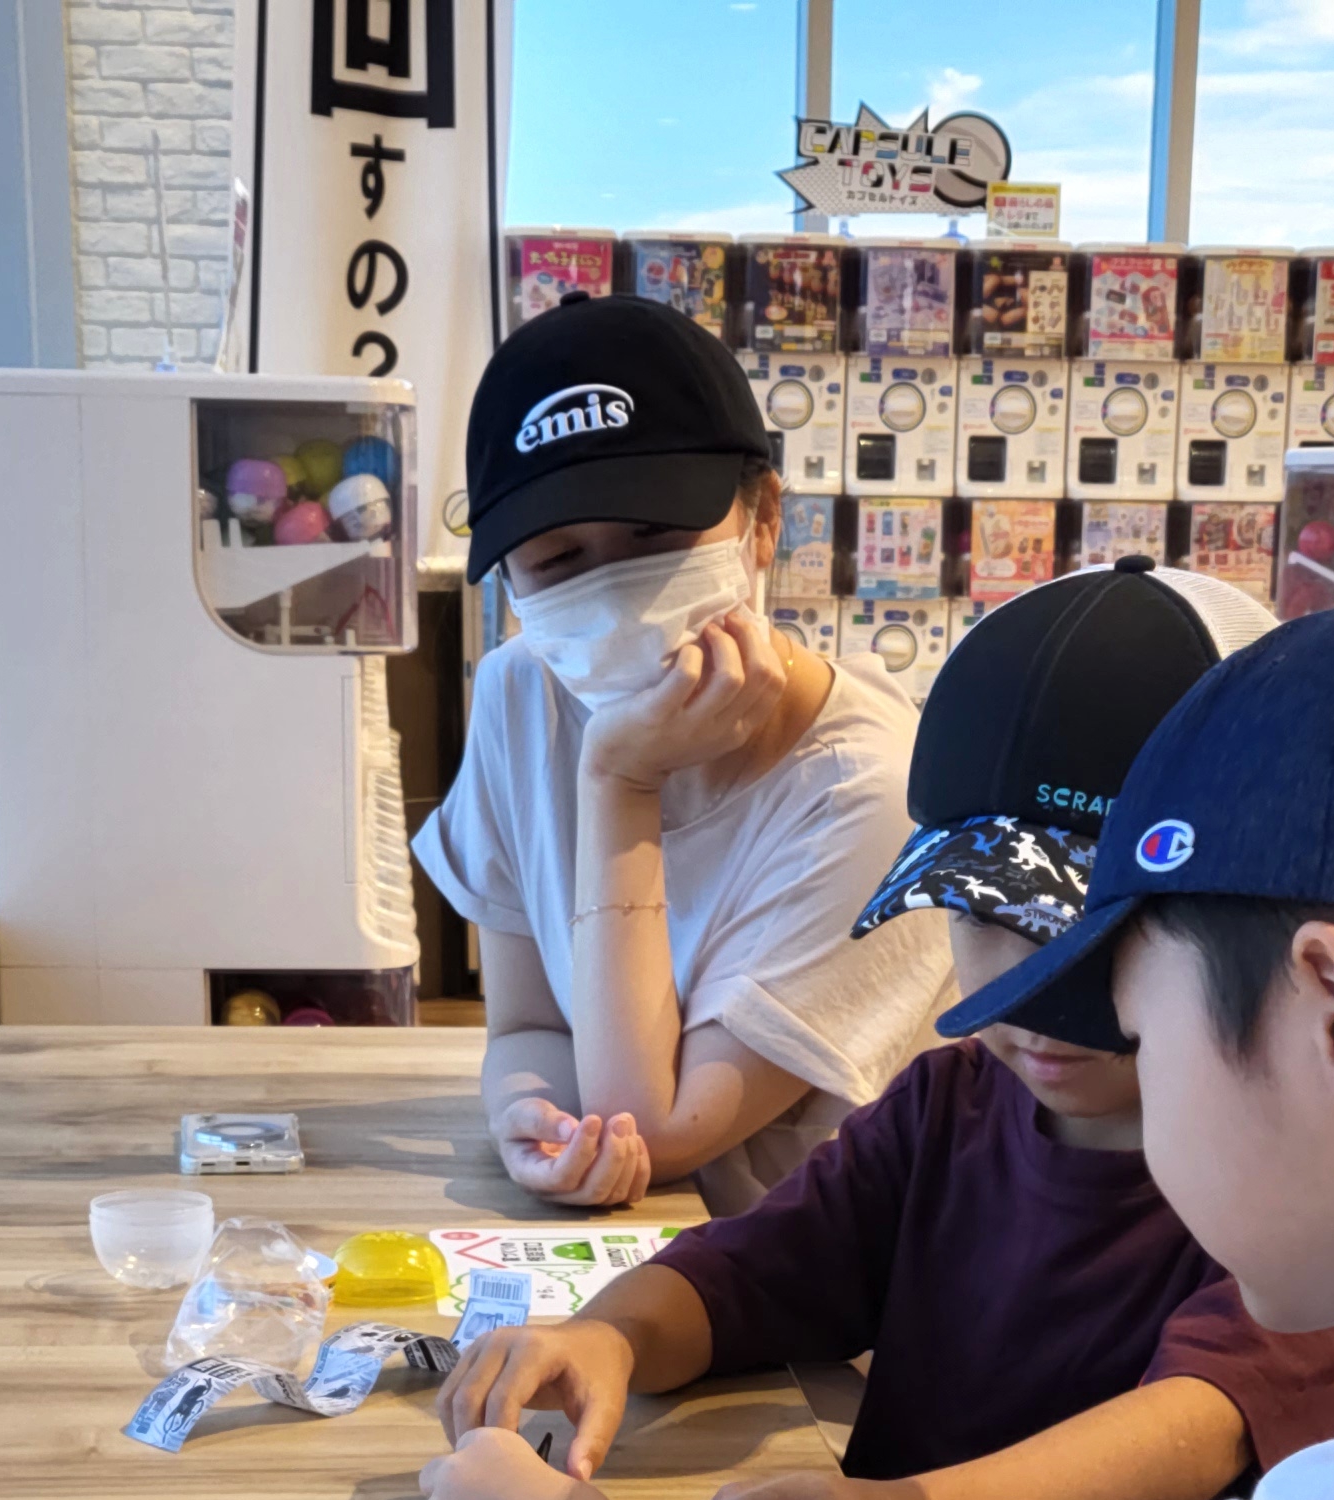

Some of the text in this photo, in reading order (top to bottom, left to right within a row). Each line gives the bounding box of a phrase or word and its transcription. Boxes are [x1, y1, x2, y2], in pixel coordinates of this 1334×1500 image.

[800, 122, 973, 167] CAPSULE
[837, 158, 933, 193] TOYS
[515, 392, 630, 453] emis
